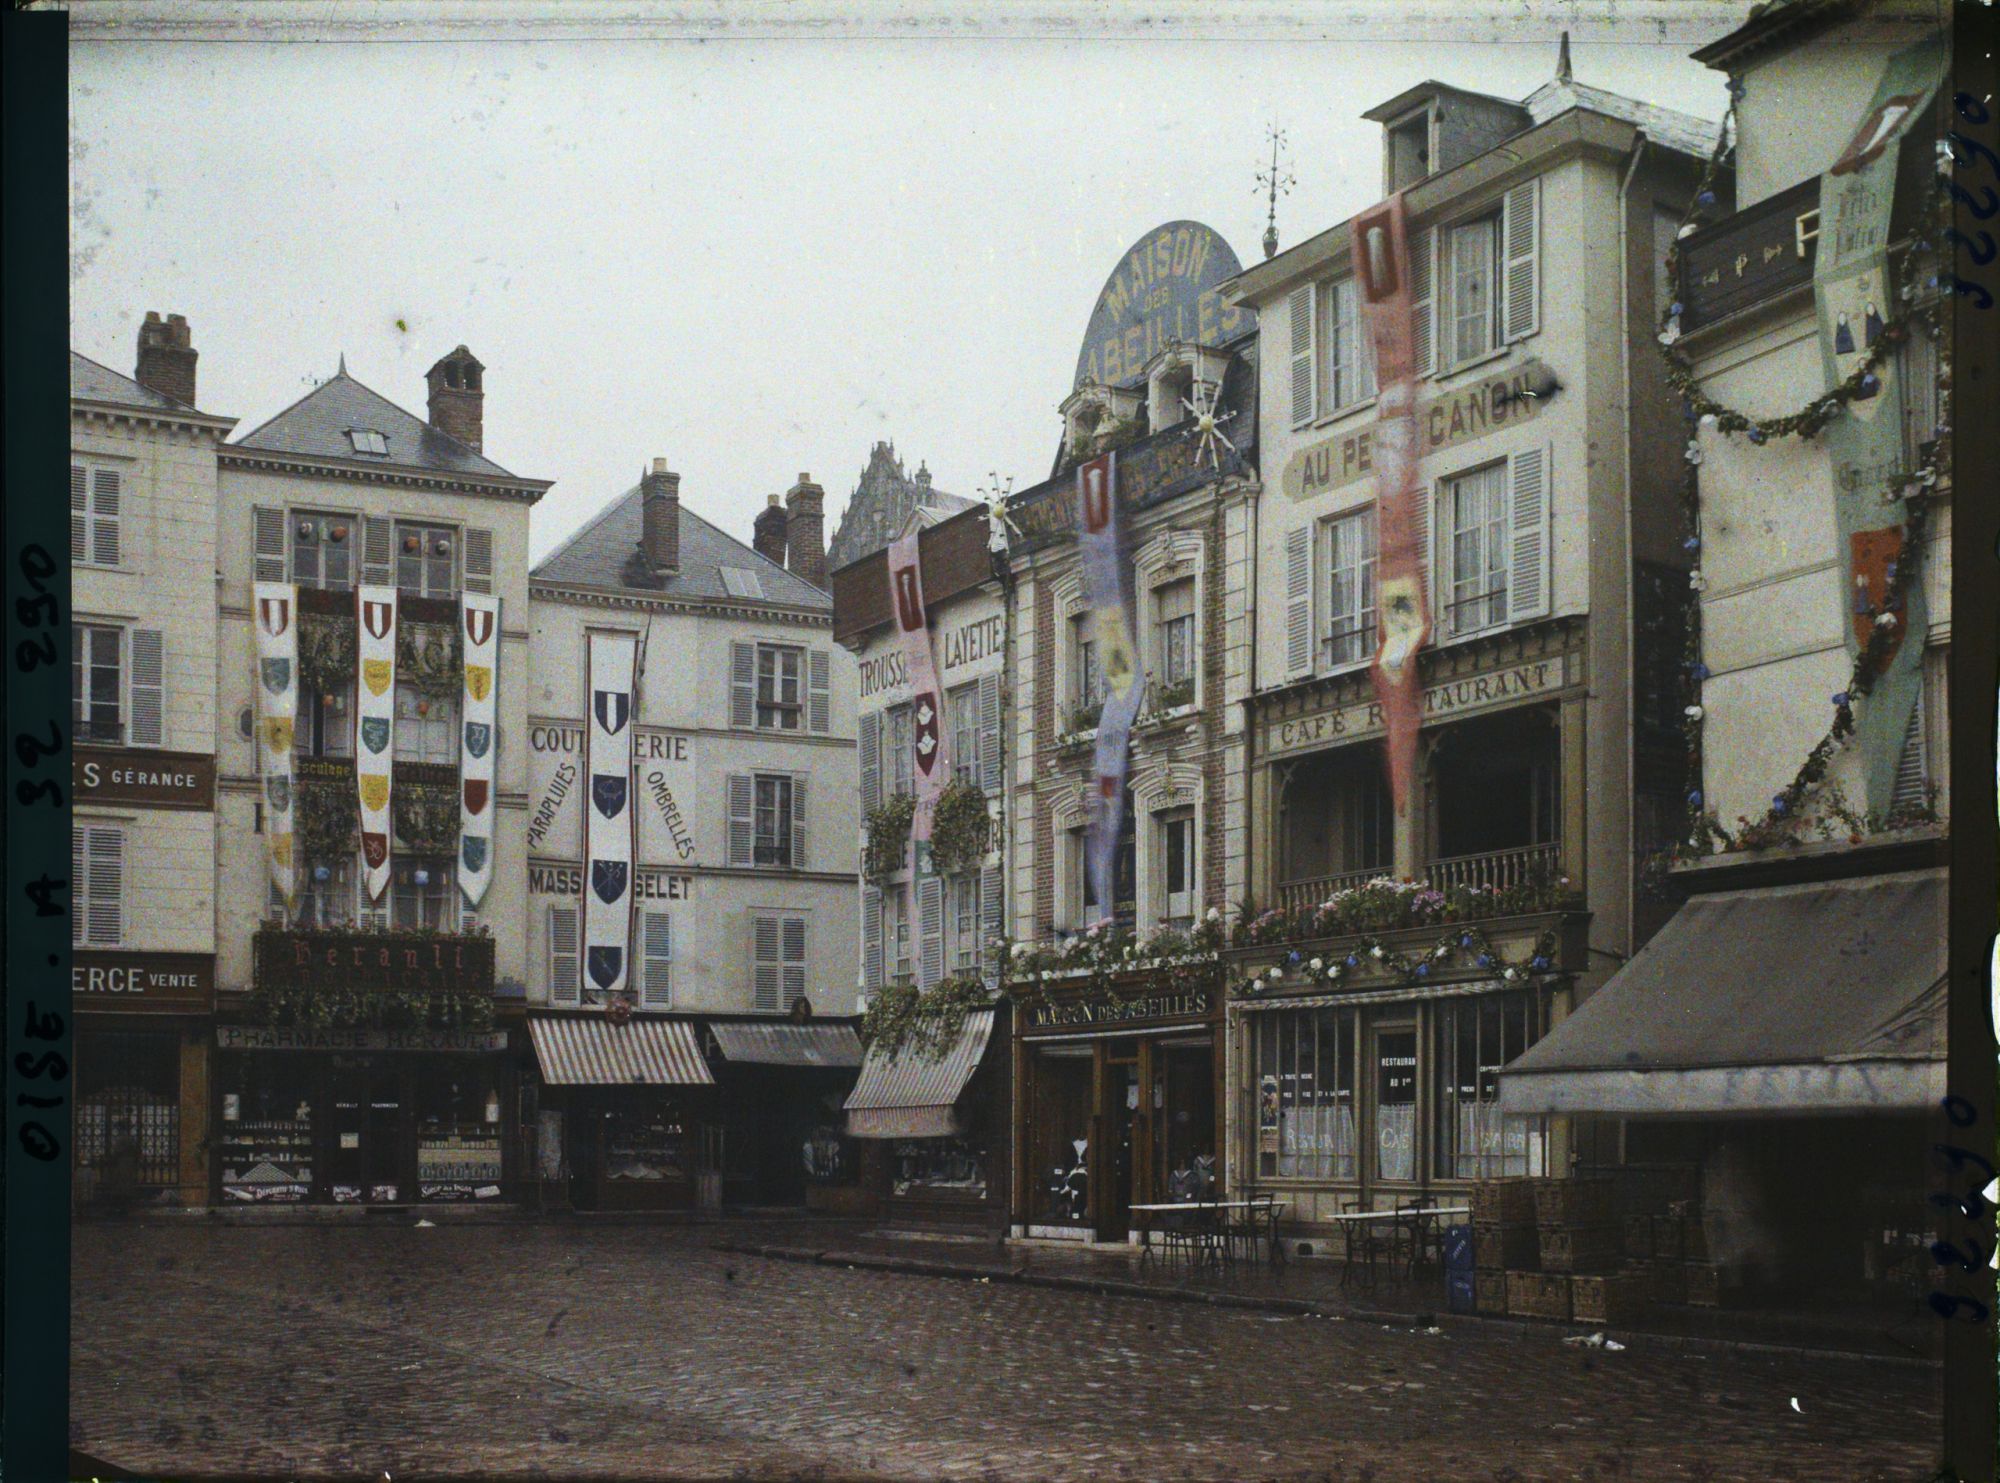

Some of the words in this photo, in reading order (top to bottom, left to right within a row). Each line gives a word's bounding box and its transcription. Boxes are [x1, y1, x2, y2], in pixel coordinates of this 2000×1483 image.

[1103, 227, 1212, 325] MAISON
[1086, 290, 1241, 386] ABEILLES
[1302, 445, 1330, 494] AU
[1429, 373, 1532, 446] CANON
[15, 544, 59, 673] 290
[1281, 708, 1345, 746] CAFÉ
[1367, 664, 1549, 726] RTAURANT
[14, 720, 63, 808] 32
[112, 767, 196, 787] GÉRANCE
[527, 762, 576, 850] PARAPLUIES
[648, 771, 695, 860] OMBRELLES
[24, 873, 66, 917] A
[149, 974, 198, 988] VENTE
[1126, 993, 1207, 1019] ABEILLES
[228, 1030, 368, 1047] PHARMACIE
[1381, 1057, 1416, 1067] RESTAURAN
[1389, 1078, 1399, 1088] AU
